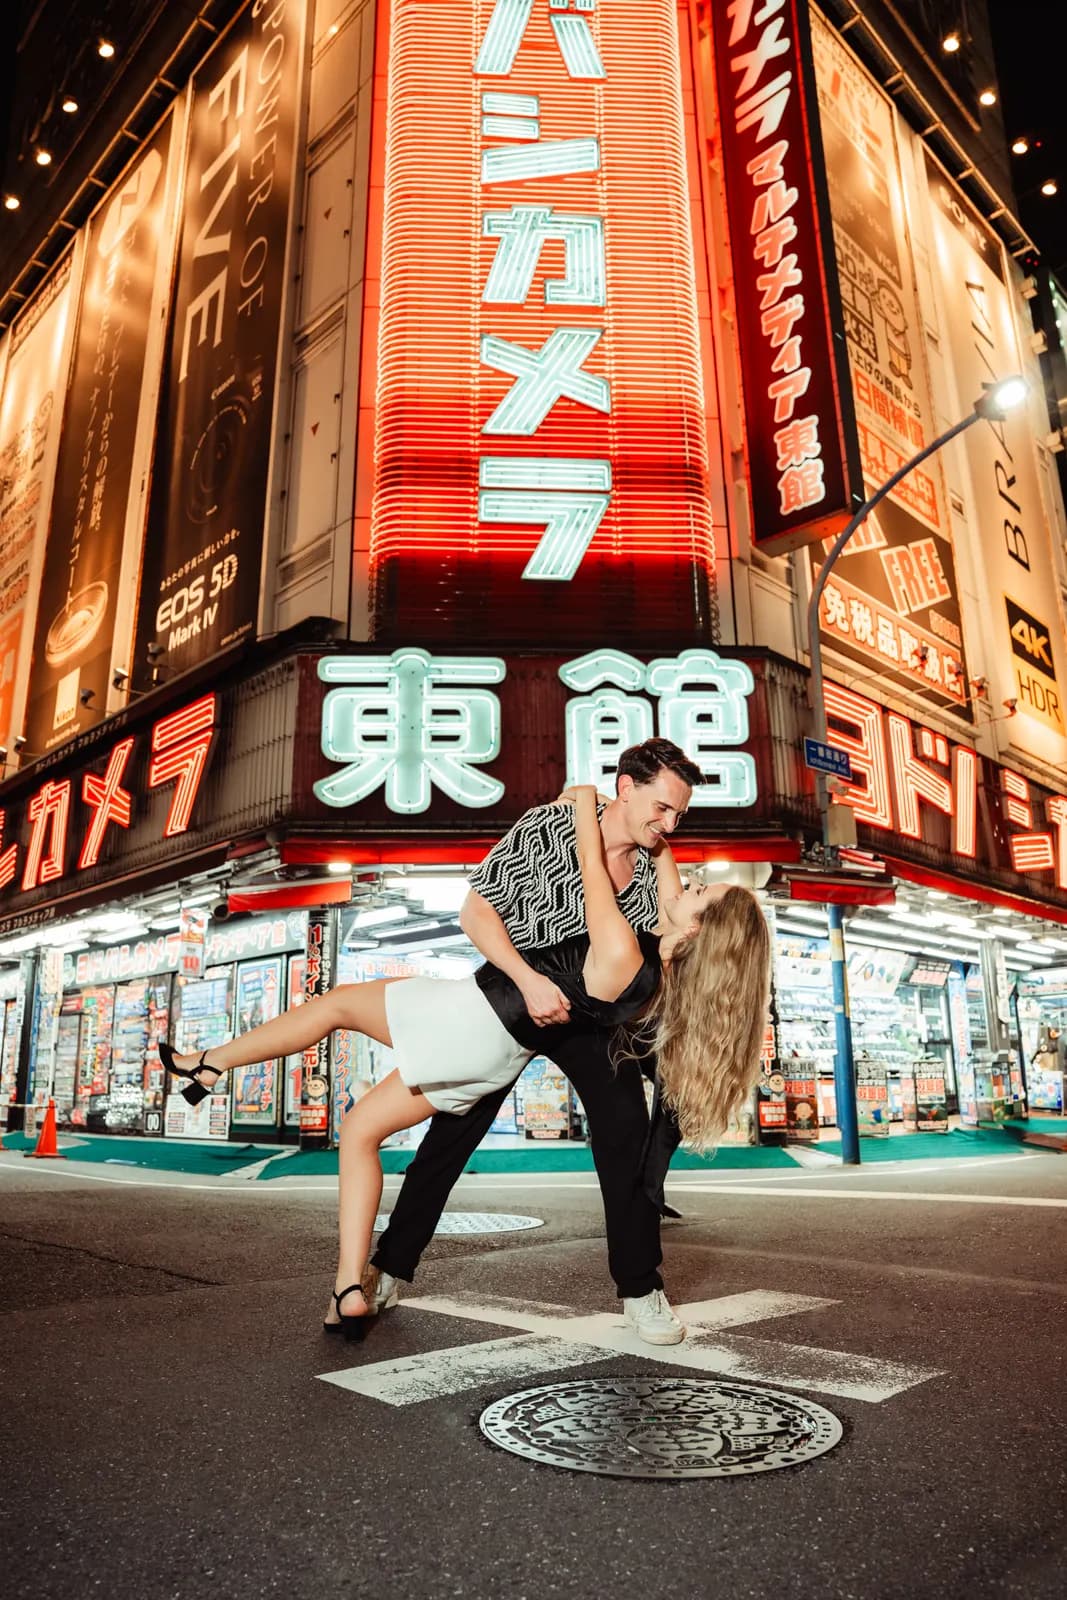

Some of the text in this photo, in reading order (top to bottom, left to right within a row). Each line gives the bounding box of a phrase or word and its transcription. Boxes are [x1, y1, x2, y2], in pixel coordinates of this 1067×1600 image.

[178, 44, 248, 383] FIVE
[237, 236, 268, 317] OF
[156, 553, 239, 632] EOS 5D
[881, 540, 950, 615] FREE
[167, 614, 202, 652] Mark
[202, 602, 219, 630] IV
[1010, 618, 1054, 669] 4K
[312, 646, 758, 814] 東館
[1017, 669, 1061, 723] HDR
